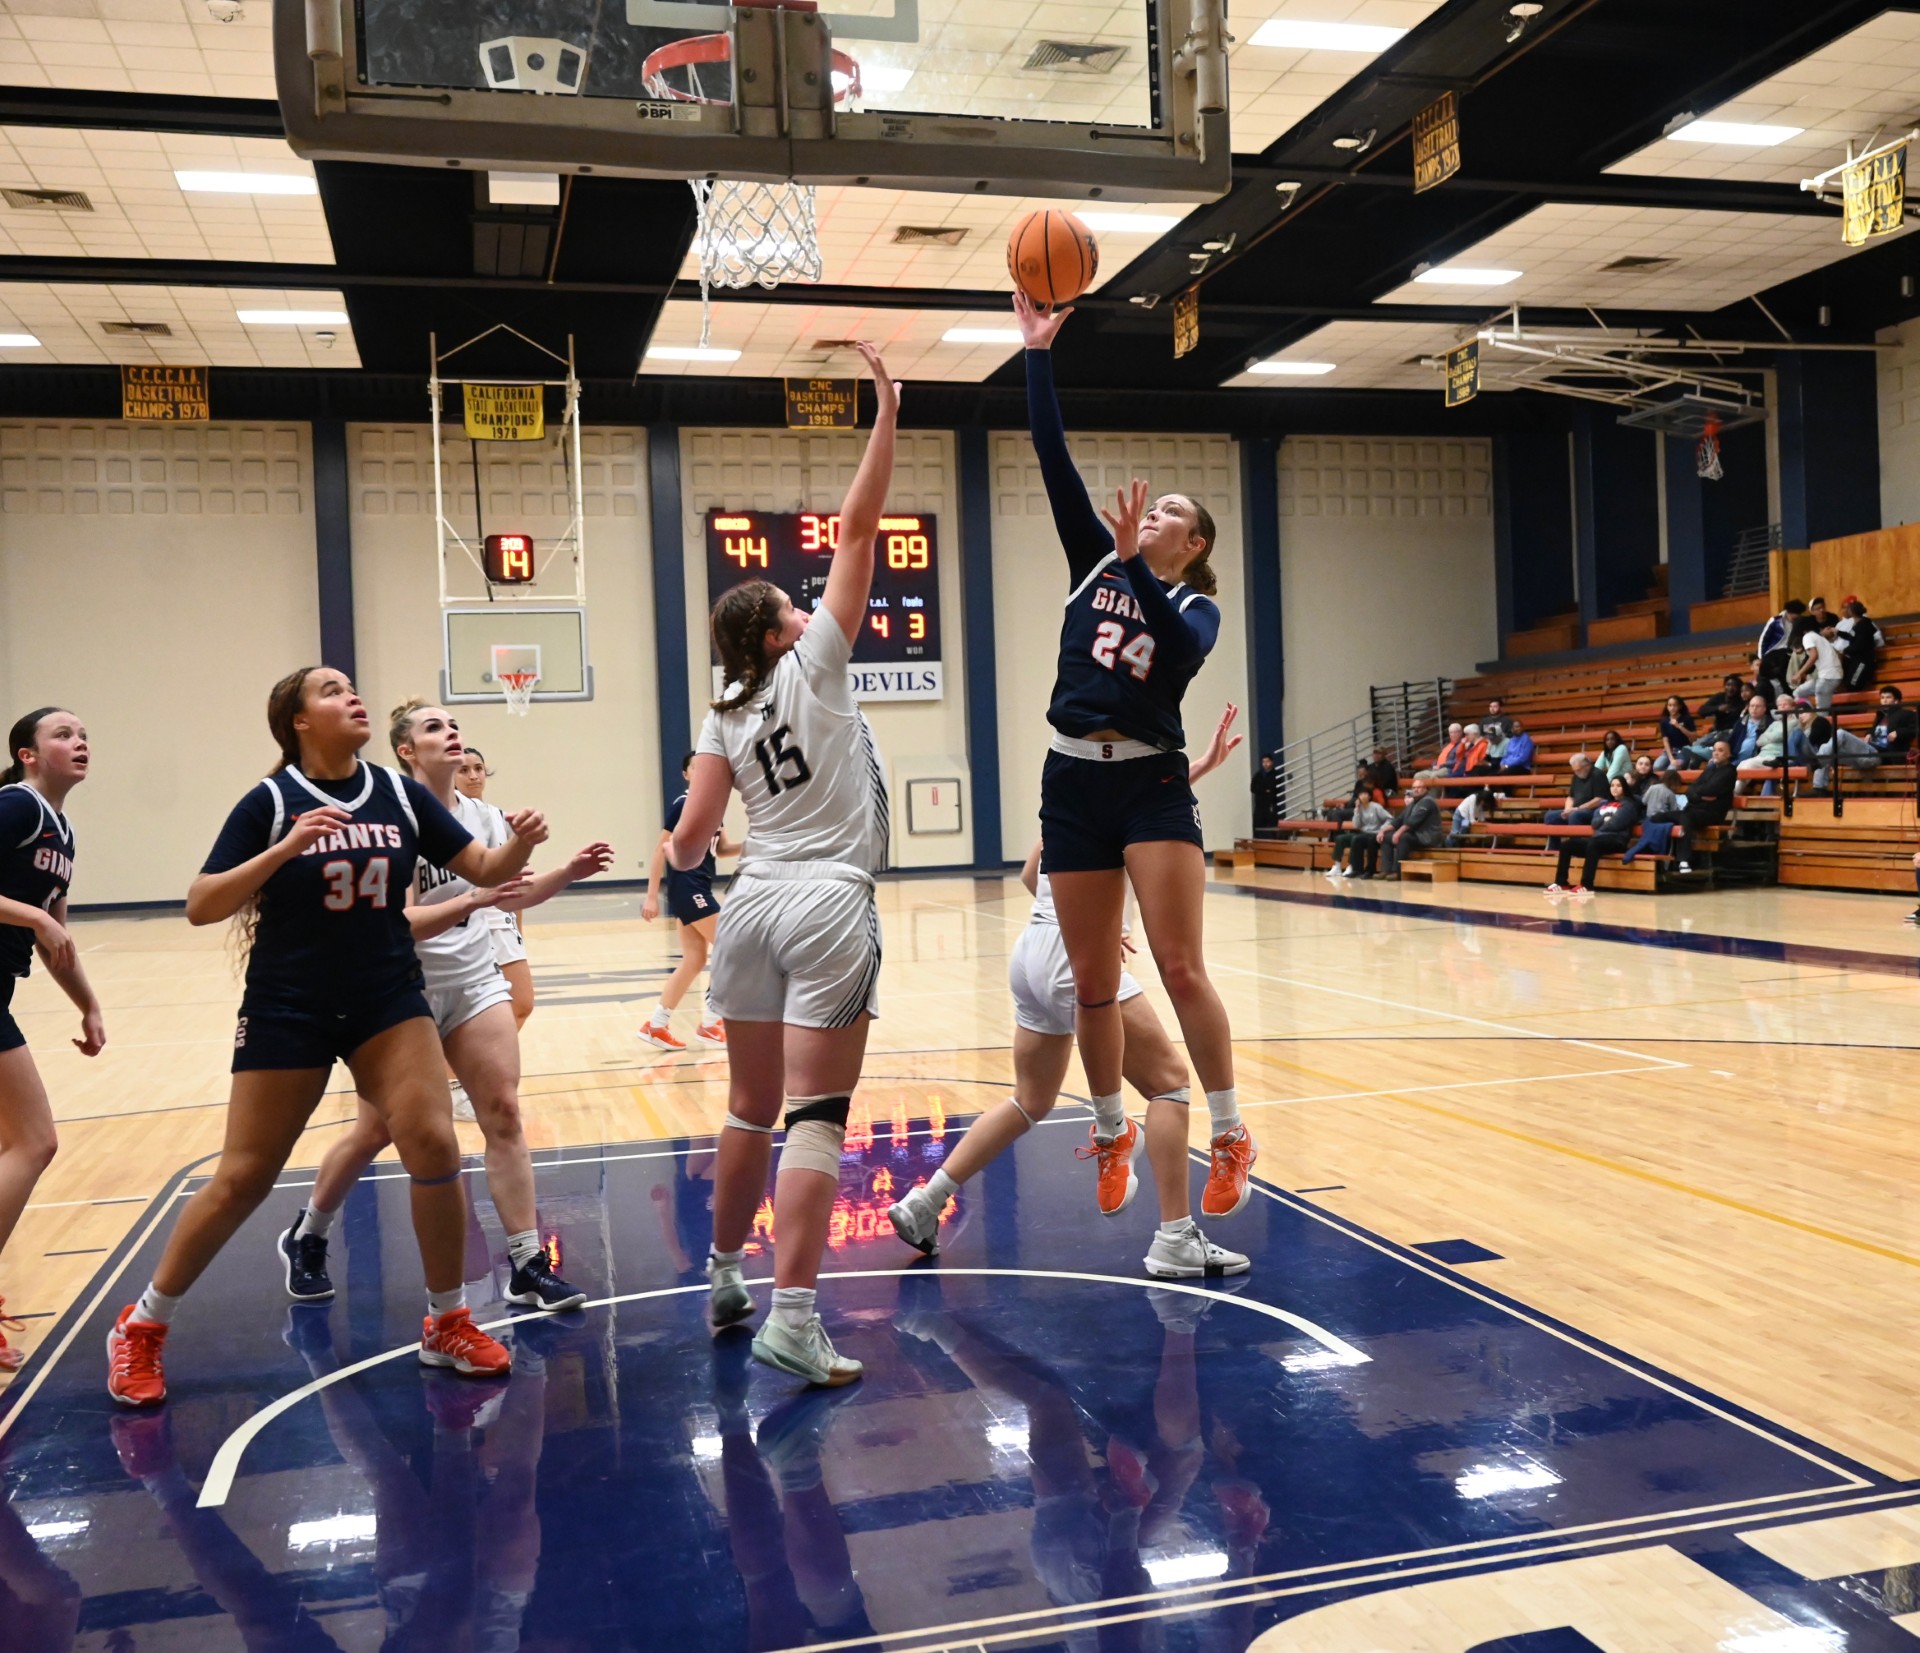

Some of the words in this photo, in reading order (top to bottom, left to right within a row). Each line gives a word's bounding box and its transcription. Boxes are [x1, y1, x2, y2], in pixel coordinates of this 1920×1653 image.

[650, 108, 672, 119] BPI
[127, 384, 204, 402] BASKETBALL
[471, 386, 535, 400] CALIFORNIA
[809, 381, 832, 391] CNC
[467, 399, 488, 412] STATE
[494, 400, 540, 413] BASKETBALL
[789, 391, 852, 403] BASKETBALL
[126, 401, 174, 419] CHAMPS
[178, 403, 207, 419] 1978
[797, 403, 845, 414] CHAMPS
[474, 413, 535, 426] CHAMPIONS
[808, 414, 834, 425] 1991
[492, 427, 518, 439] 1978
[800, 516, 841, 550] 3:0
[725, 537, 768, 568] 44
[887, 535, 929, 569] 89
[503, 550, 529, 578] 14
[1091, 586, 1147, 625] GIAN
[871, 614, 888, 638] 4
[909, 613, 925, 639] 3
[906, 646, 923, 655] won
[1091, 620, 1156, 683] 24
[755, 723, 812, 797] 15
[1102, 744, 1113, 759] S
[33, 846, 72, 883] GIAN
[323, 856, 390, 911] 34
